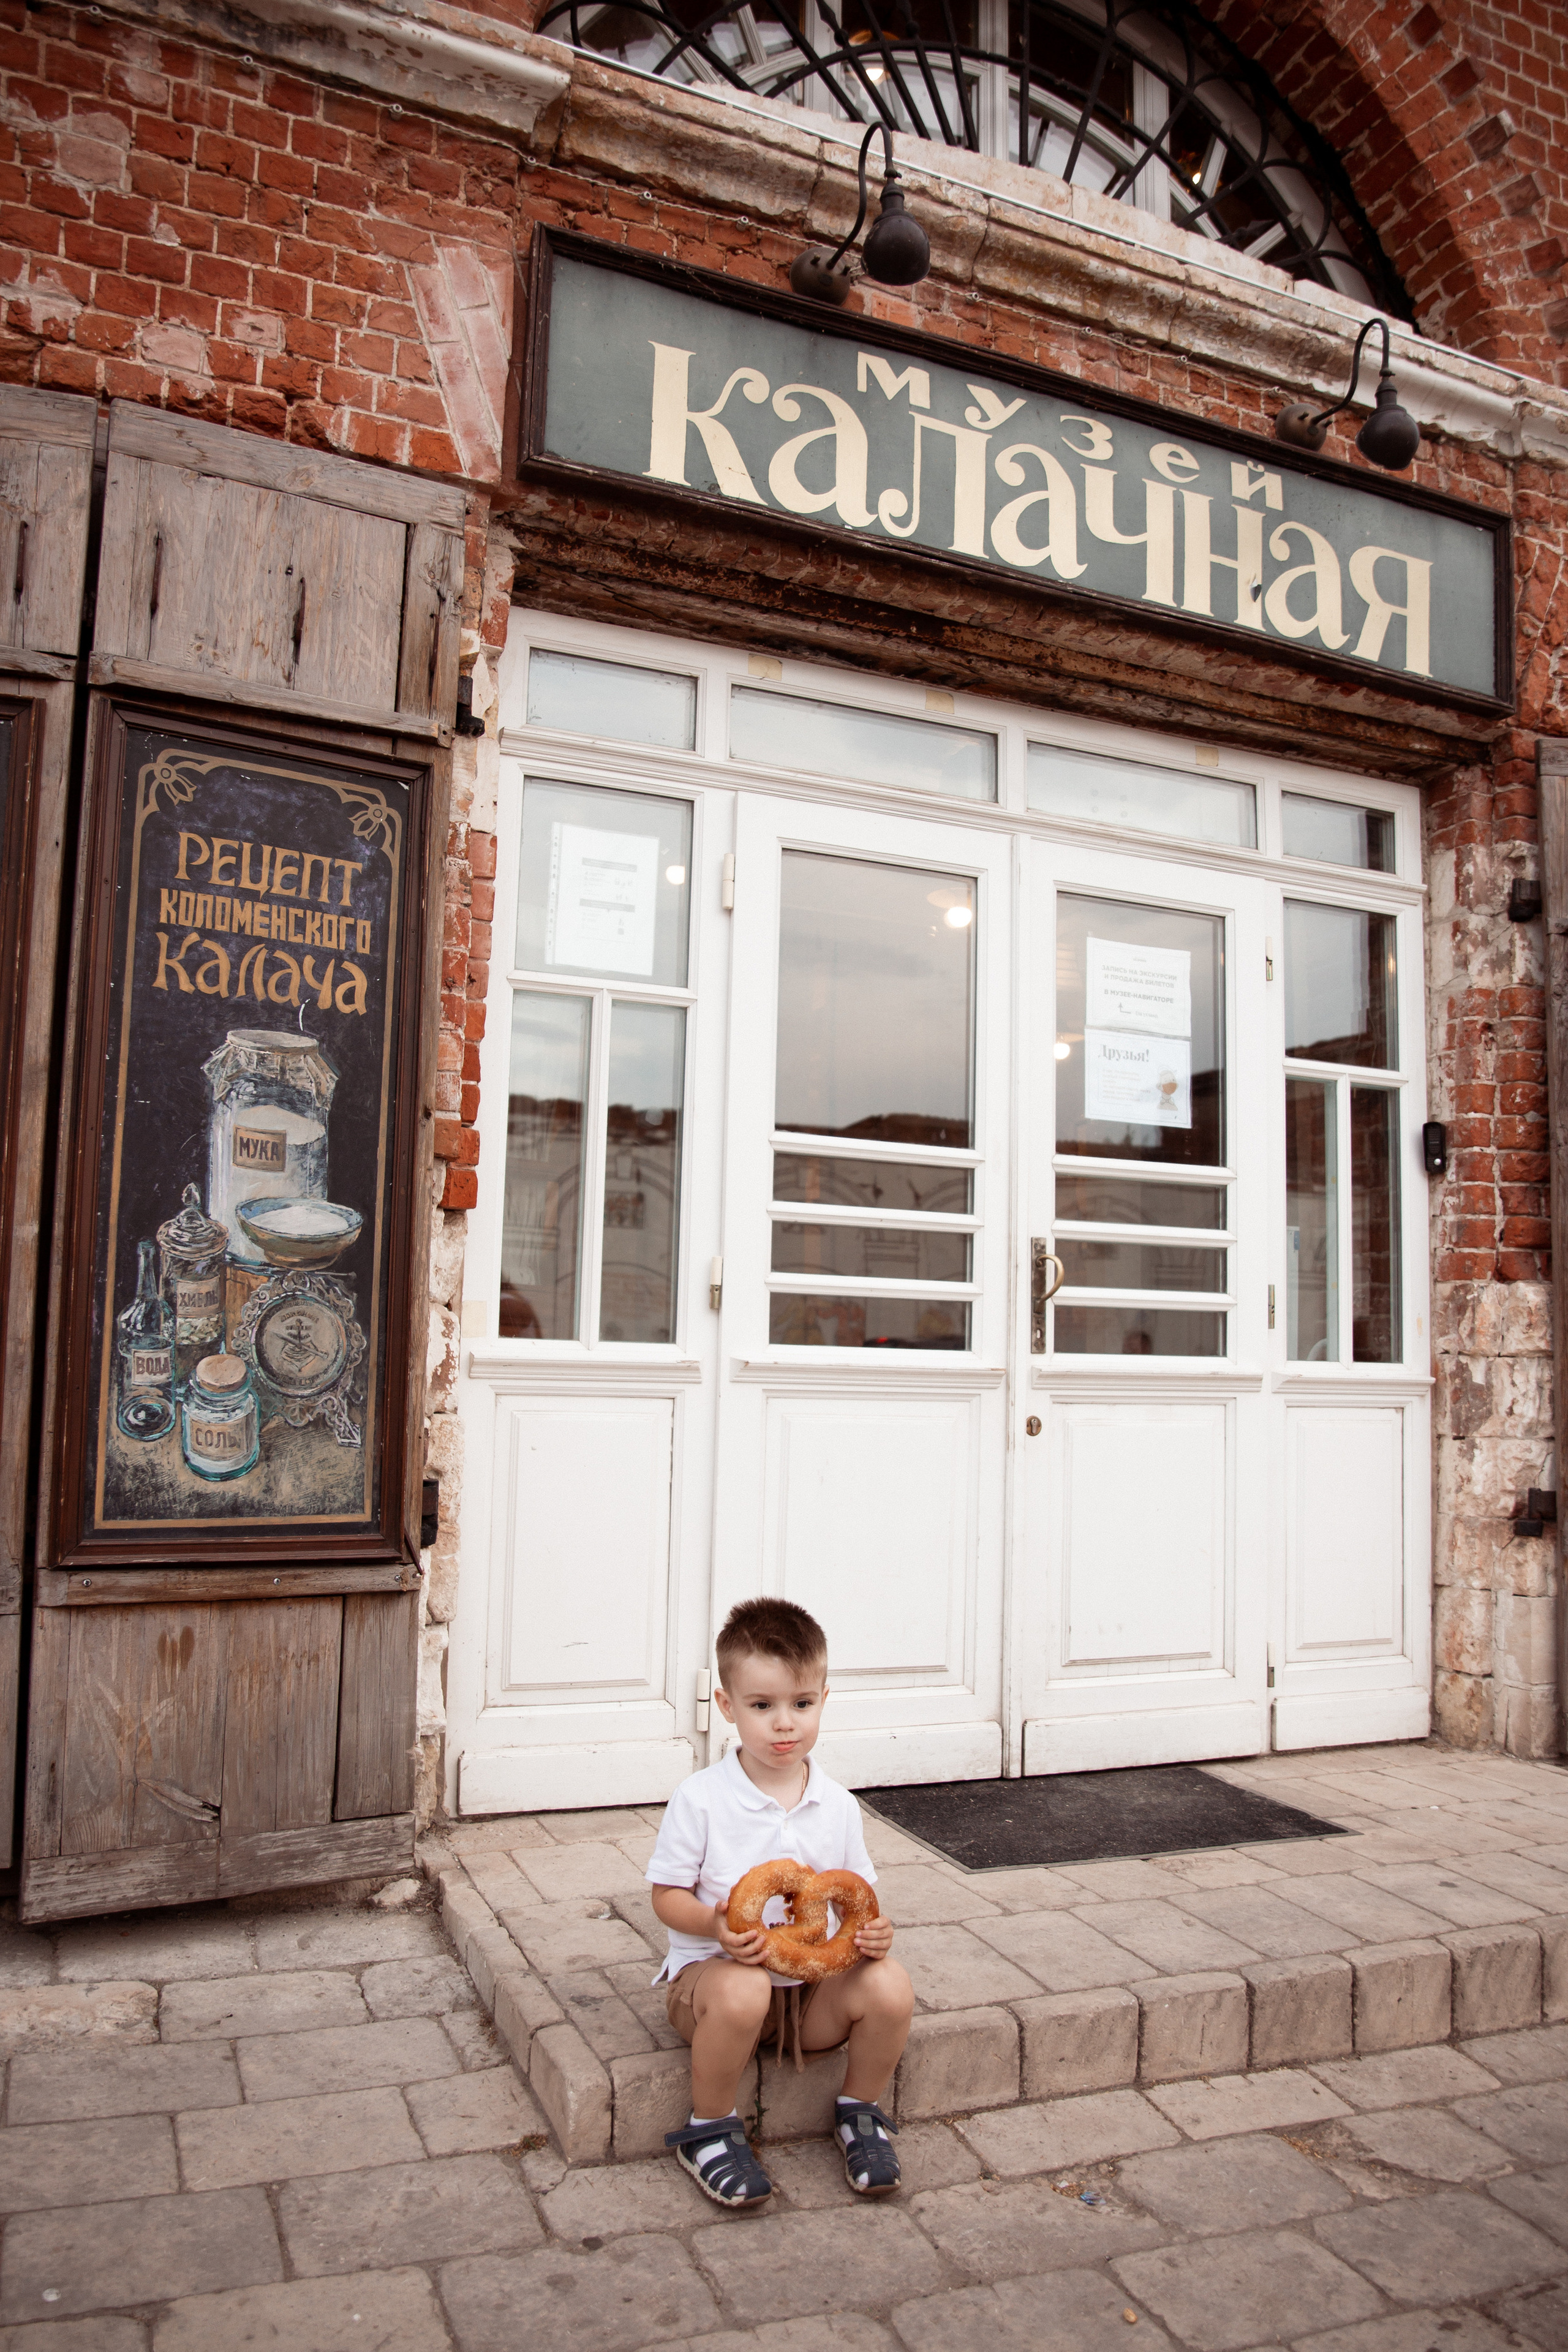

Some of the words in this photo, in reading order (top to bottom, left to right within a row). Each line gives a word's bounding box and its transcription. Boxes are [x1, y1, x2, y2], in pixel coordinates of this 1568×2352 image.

[174, 831, 362, 907] РЕЦЕПТ
[159, 888, 371, 954] КОЛОМЕНСКОГО
[1101, 965, 1128, 974] ЗАПИСЬ
[1139, 970, 1177, 981] ЭКСКУРСИИ
[1110, 974, 1144, 984] ПРОДАЖА
[1145, 979, 1174, 989] БИЛЕТОВ
[1110, 990, 1174, 1004] МУЗЕЕ-НАВИГАТОРЕ
[1098, 1044, 1150, 1063] Друзья!
[239, 1136, 280, 1161] МУКА
[136, 1356, 170, 1376] ВОДА
[195, 1428, 237, 1449] СОЛЬ
